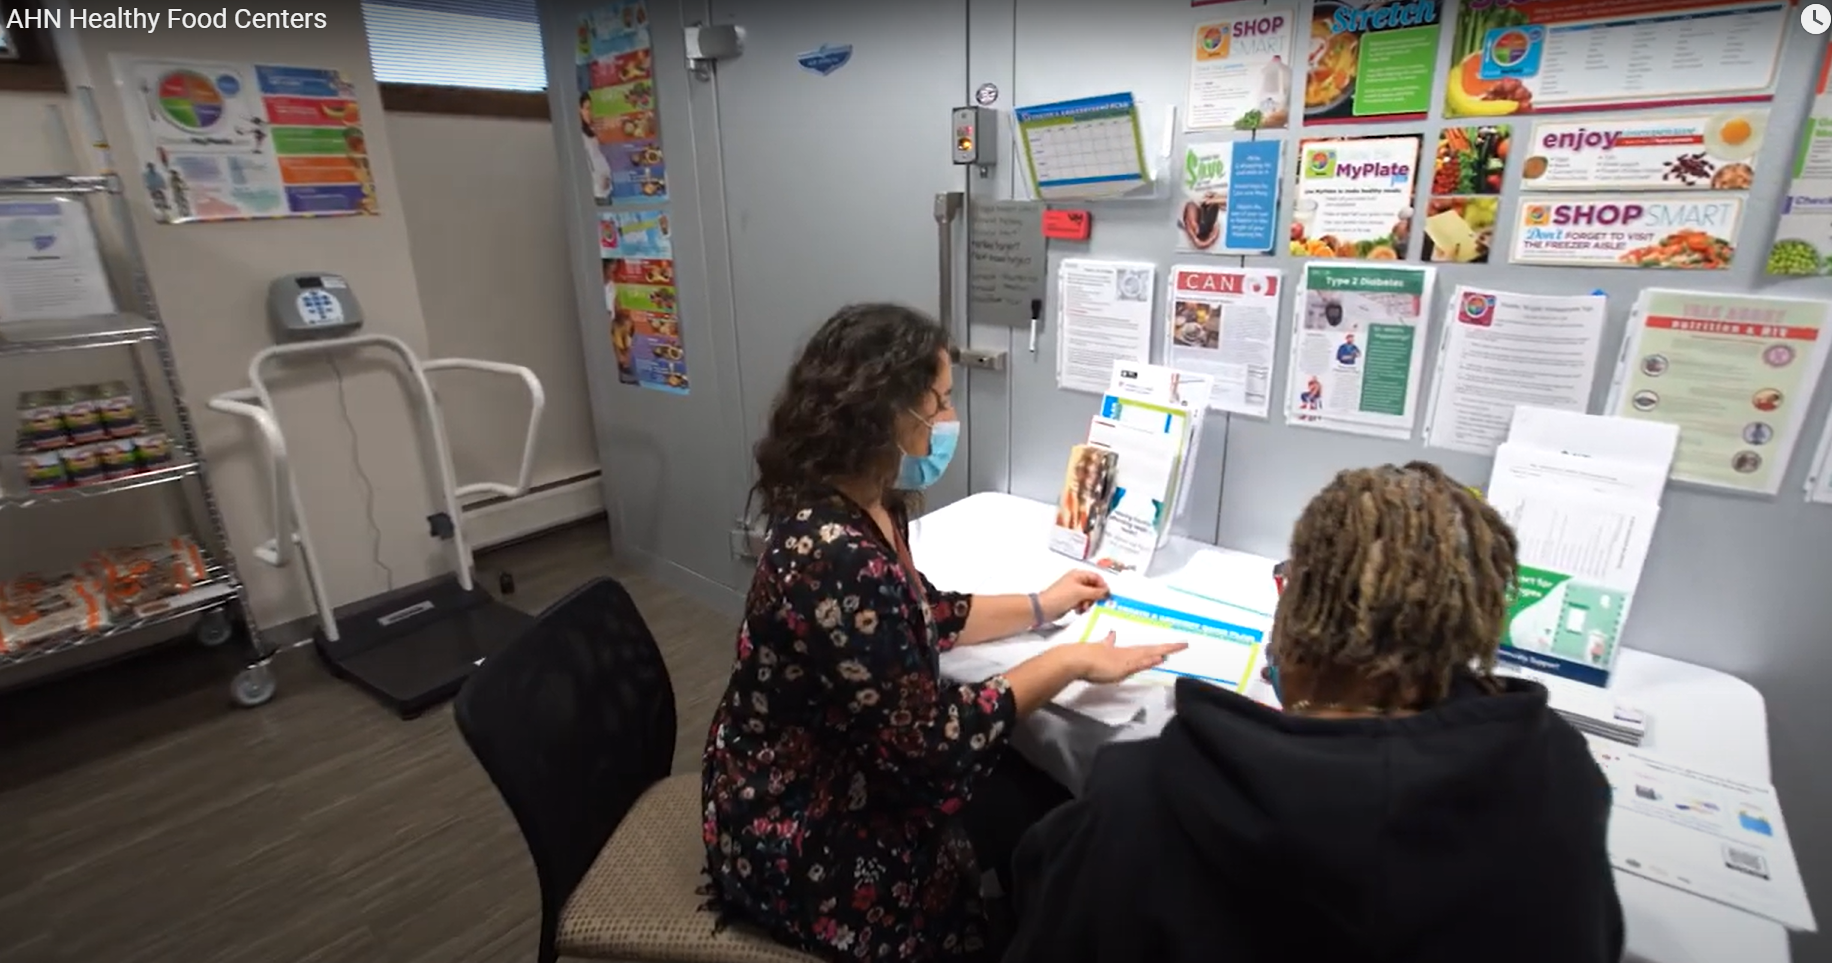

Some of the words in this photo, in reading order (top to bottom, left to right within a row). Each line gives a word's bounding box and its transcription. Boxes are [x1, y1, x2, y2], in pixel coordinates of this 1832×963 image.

[1233, 16, 1284, 37] SHOP
[1332, 0, 1436, 34] Stretch
[1233, 35, 1286, 55] SMART
[1543, 128, 1622, 150] enjoy
[1336, 162, 1409, 179] MyPlate
[1553, 205, 1643, 226] SHOP
[1645, 203, 1732, 227] SMART
[1526, 228, 1563, 241] Don't
[1565, 231, 1607, 240] FORGET
[1610, 232, 1625, 240] TO
[1627, 232, 1655, 241] VISIT
[1523, 240, 1543, 249] THE
[1544, 241, 1591, 249] FREEZER
[1186, 273, 1236, 292] CAN
[1326, 276, 1350, 286] Type
[1352, 277, 1358, 285] 2
[1360, 277, 1405, 287] Diabetes
